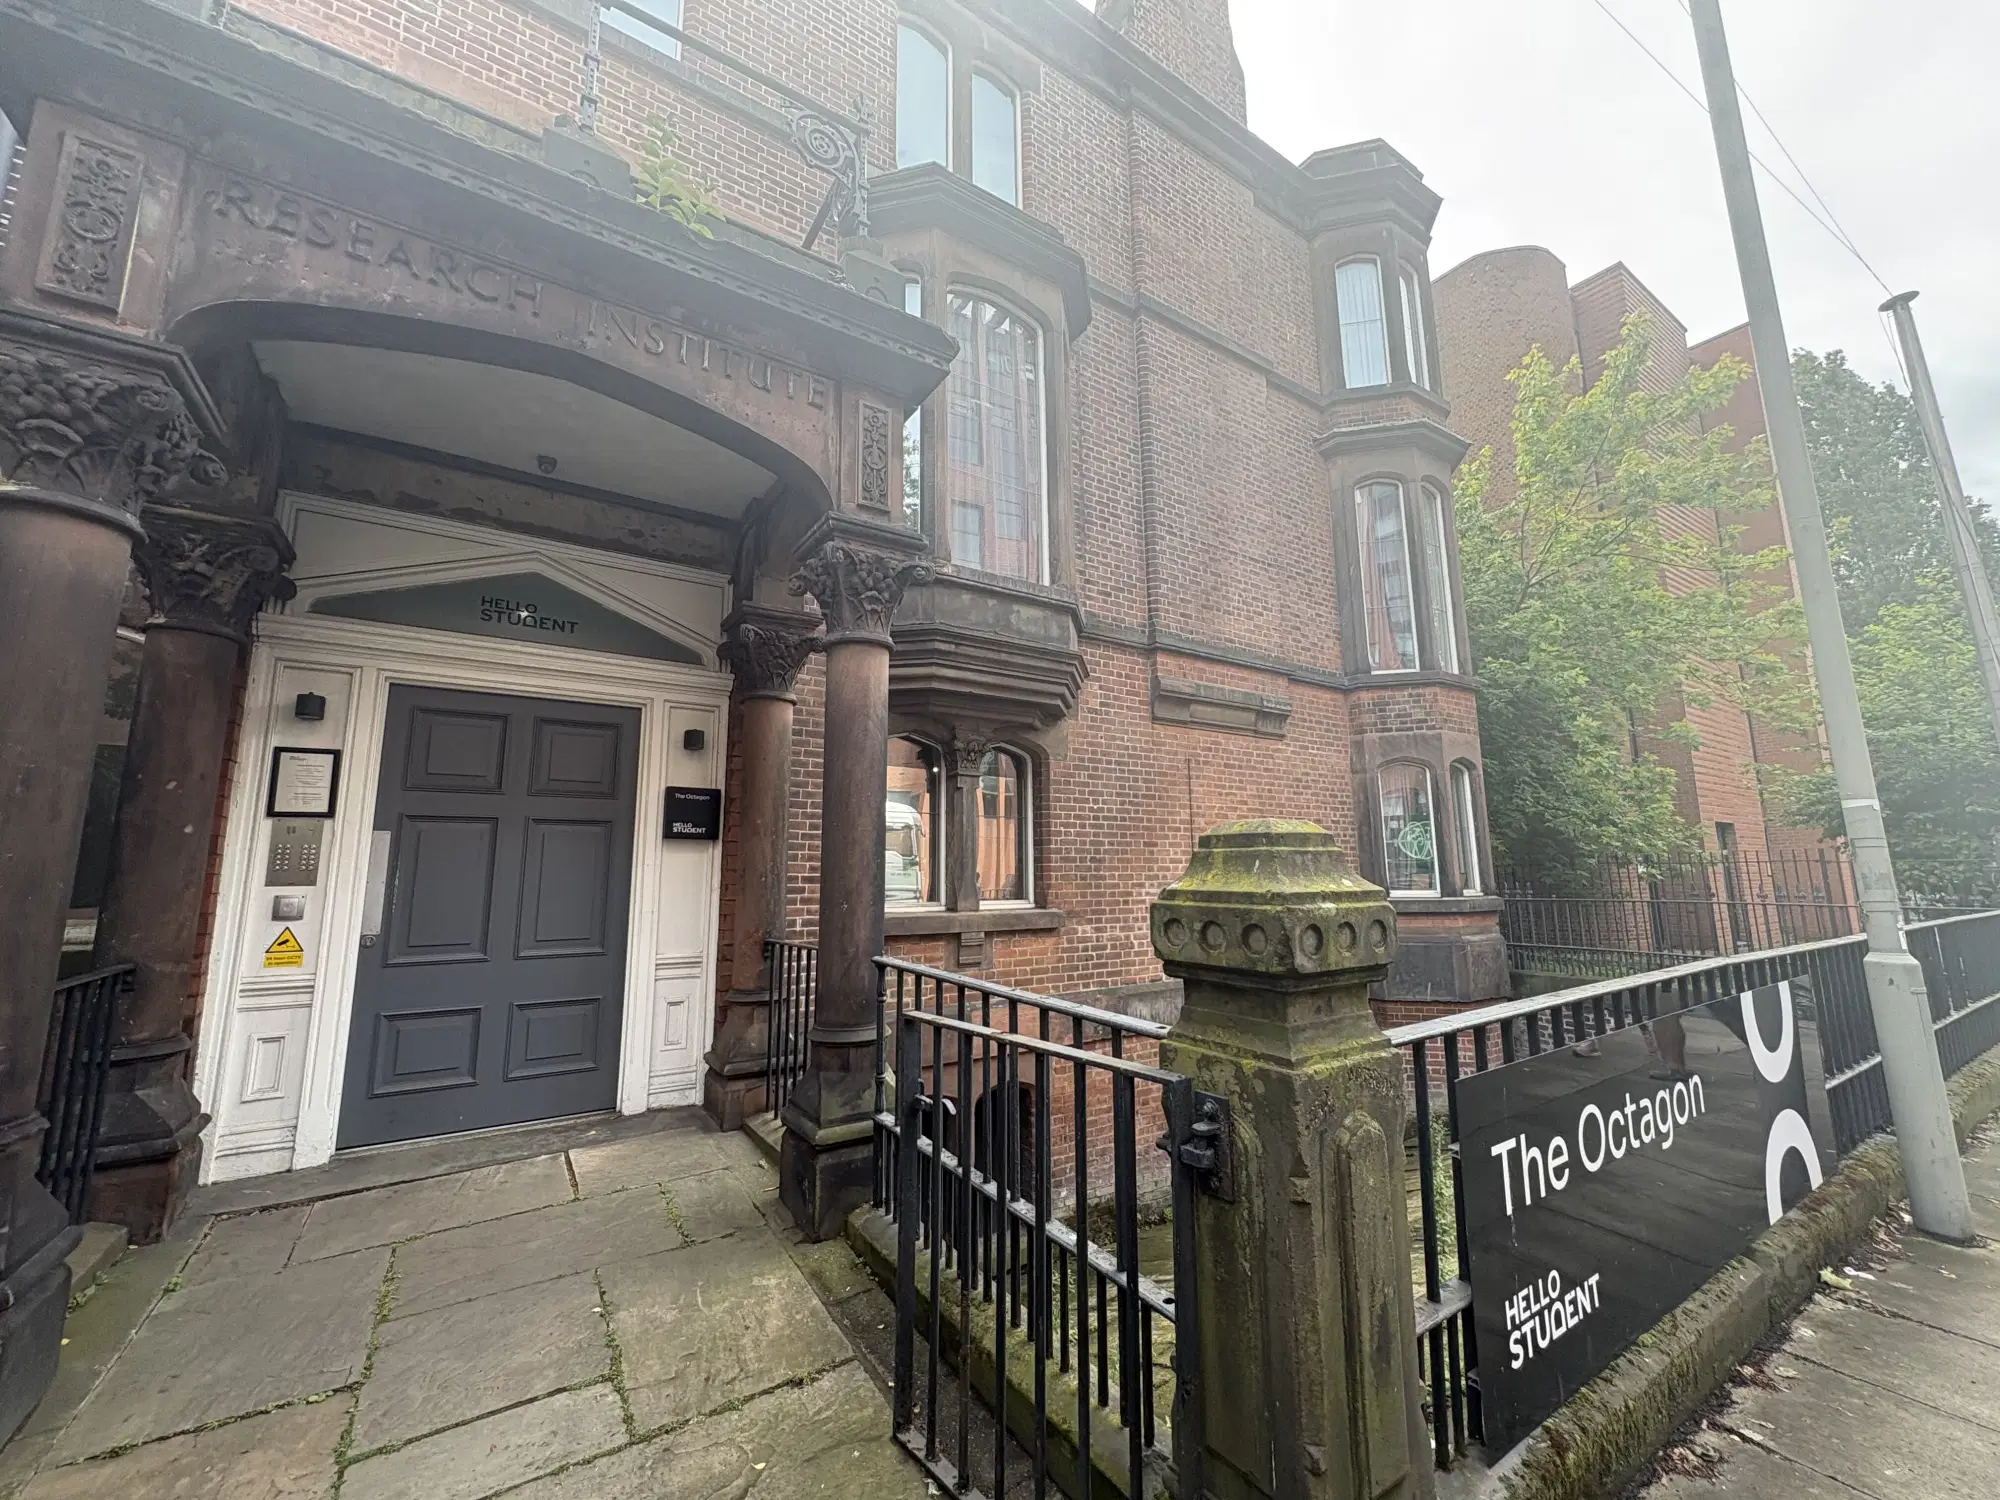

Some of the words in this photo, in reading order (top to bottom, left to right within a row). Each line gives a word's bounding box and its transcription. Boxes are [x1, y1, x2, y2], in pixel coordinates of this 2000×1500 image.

[205, 182, 543, 318] RESEARCH
[588, 300, 824, 409] INSTITUTE
[480, 595, 538, 614] HELLO
[480, 608, 579, 634] STUDENT
[1491, 1132, 1570, 1217] The
[1578, 1074, 1705, 1173] Octagon
[1505, 1269, 1561, 1331] HELLO
[1509, 1272, 1600, 1371] STUDENT
